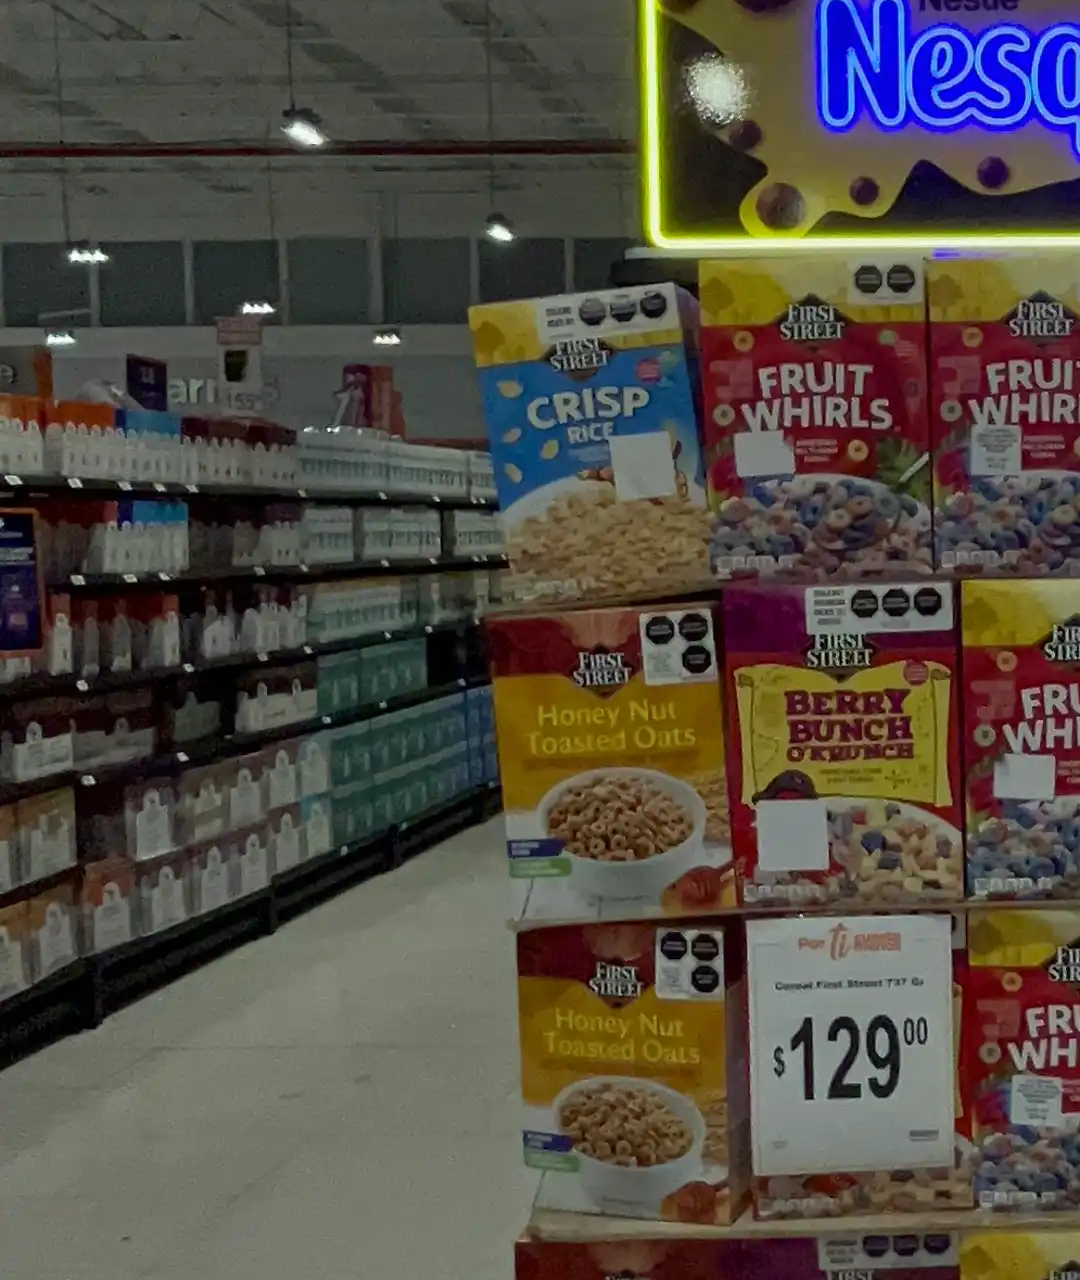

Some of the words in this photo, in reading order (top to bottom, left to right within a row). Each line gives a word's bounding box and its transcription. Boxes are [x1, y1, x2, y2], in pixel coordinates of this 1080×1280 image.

[788, 304, 836, 322] FIRST
[1016, 300, 1064, 319] FIRST
[758, 363, 873, 399] FRUIT
[527, 387, 650, 430] CRISP
[741, 396, 893, 431] WHIRLS
[567, 422, 614, 444] RICE
[578, 652, 624, 670] FIRST
[538, 704, 620, 729] Honey
[629, 699, 676, 721] Nut
[784, 689, 911, 716] BERRY
[524, 730, 626, 756] Toasted
[634, 725, 697, 750] Oats
[788, 717, 913, 743] BUNCH
[597, 962, 638, 980] FIRST
[555, 1008, 629, 1037] Honey
[639, 1014, 684, 1037] Nut
[543, 1032, 635, 1060] Toasted
[642, 1039, 700, 1065] Oats
